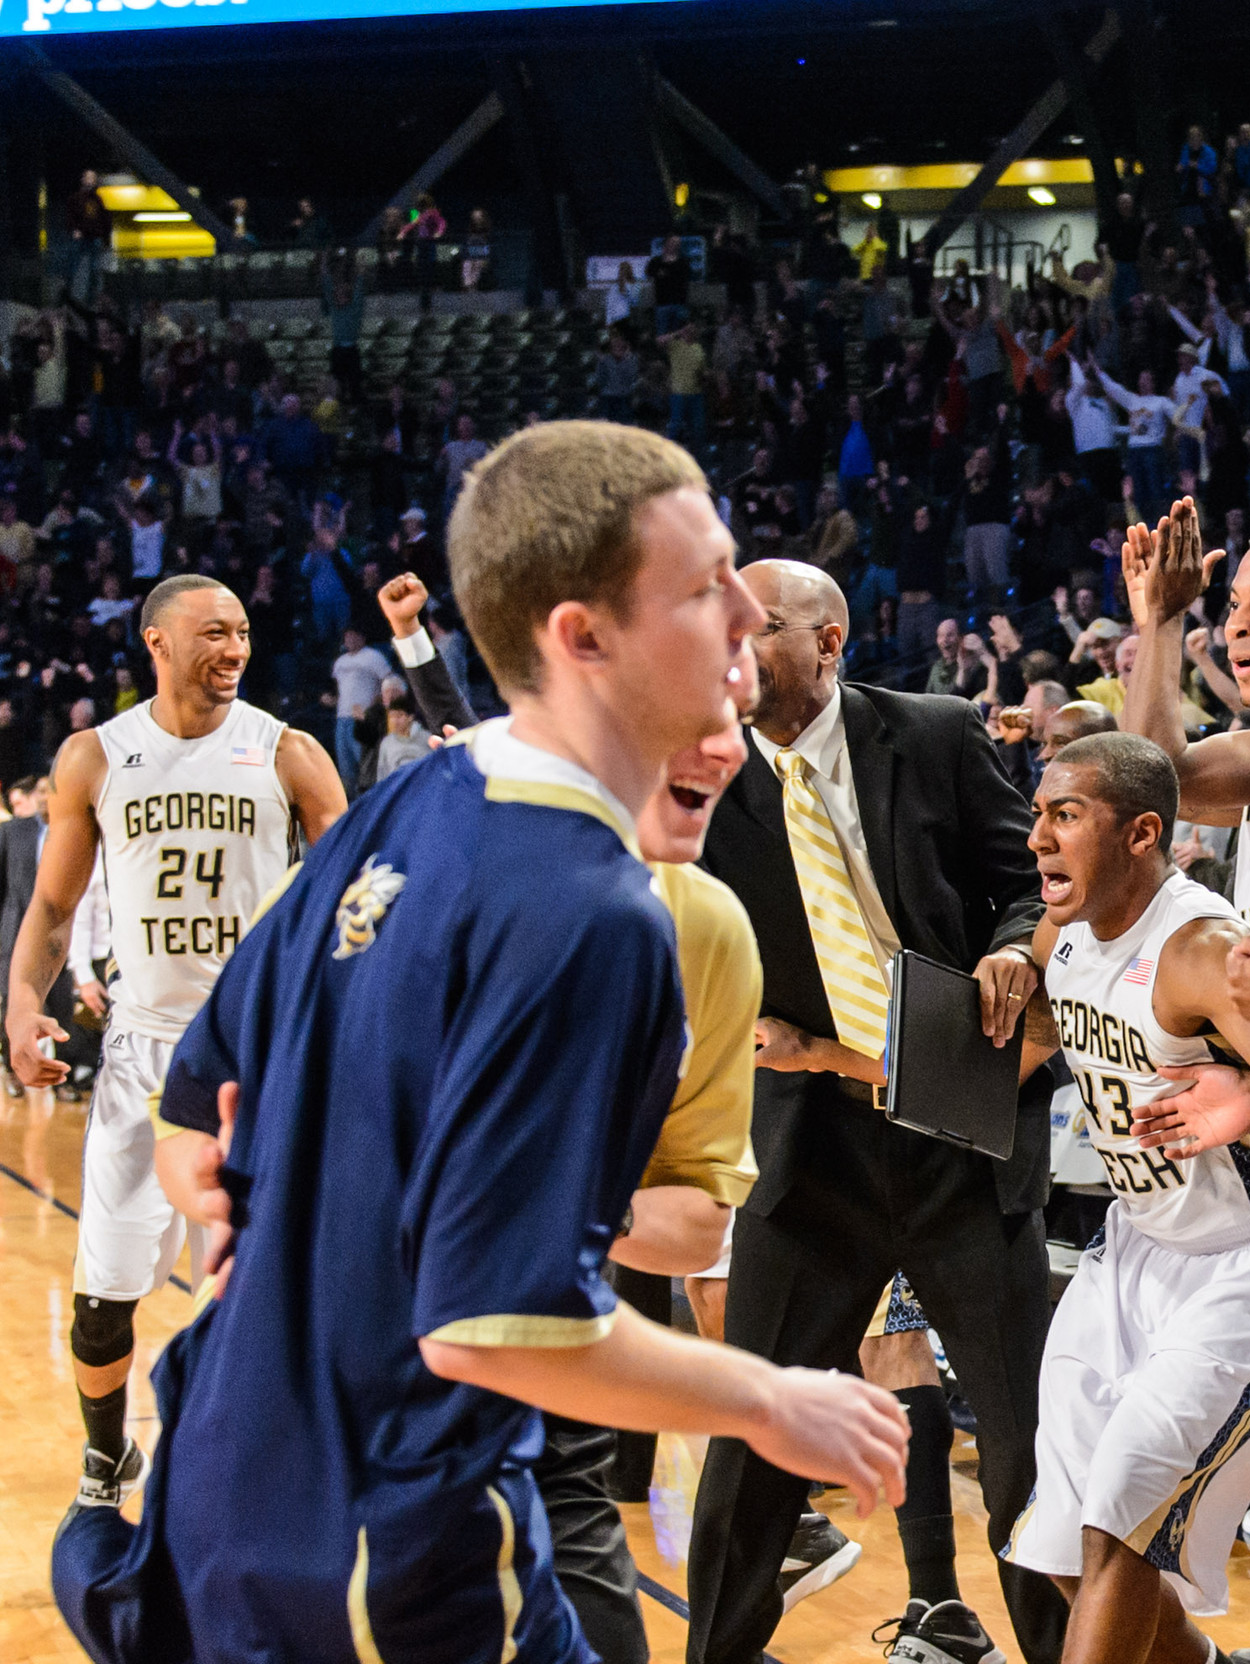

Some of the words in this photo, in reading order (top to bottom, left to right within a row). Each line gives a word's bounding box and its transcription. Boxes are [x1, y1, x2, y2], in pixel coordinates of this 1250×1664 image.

[125, 792, 256, 840] GEORGIA
[155, 846, 226, 900] 24
[140, 915, 240, 956] TECH
[1092, 1144, 1187, 1194] ECH
